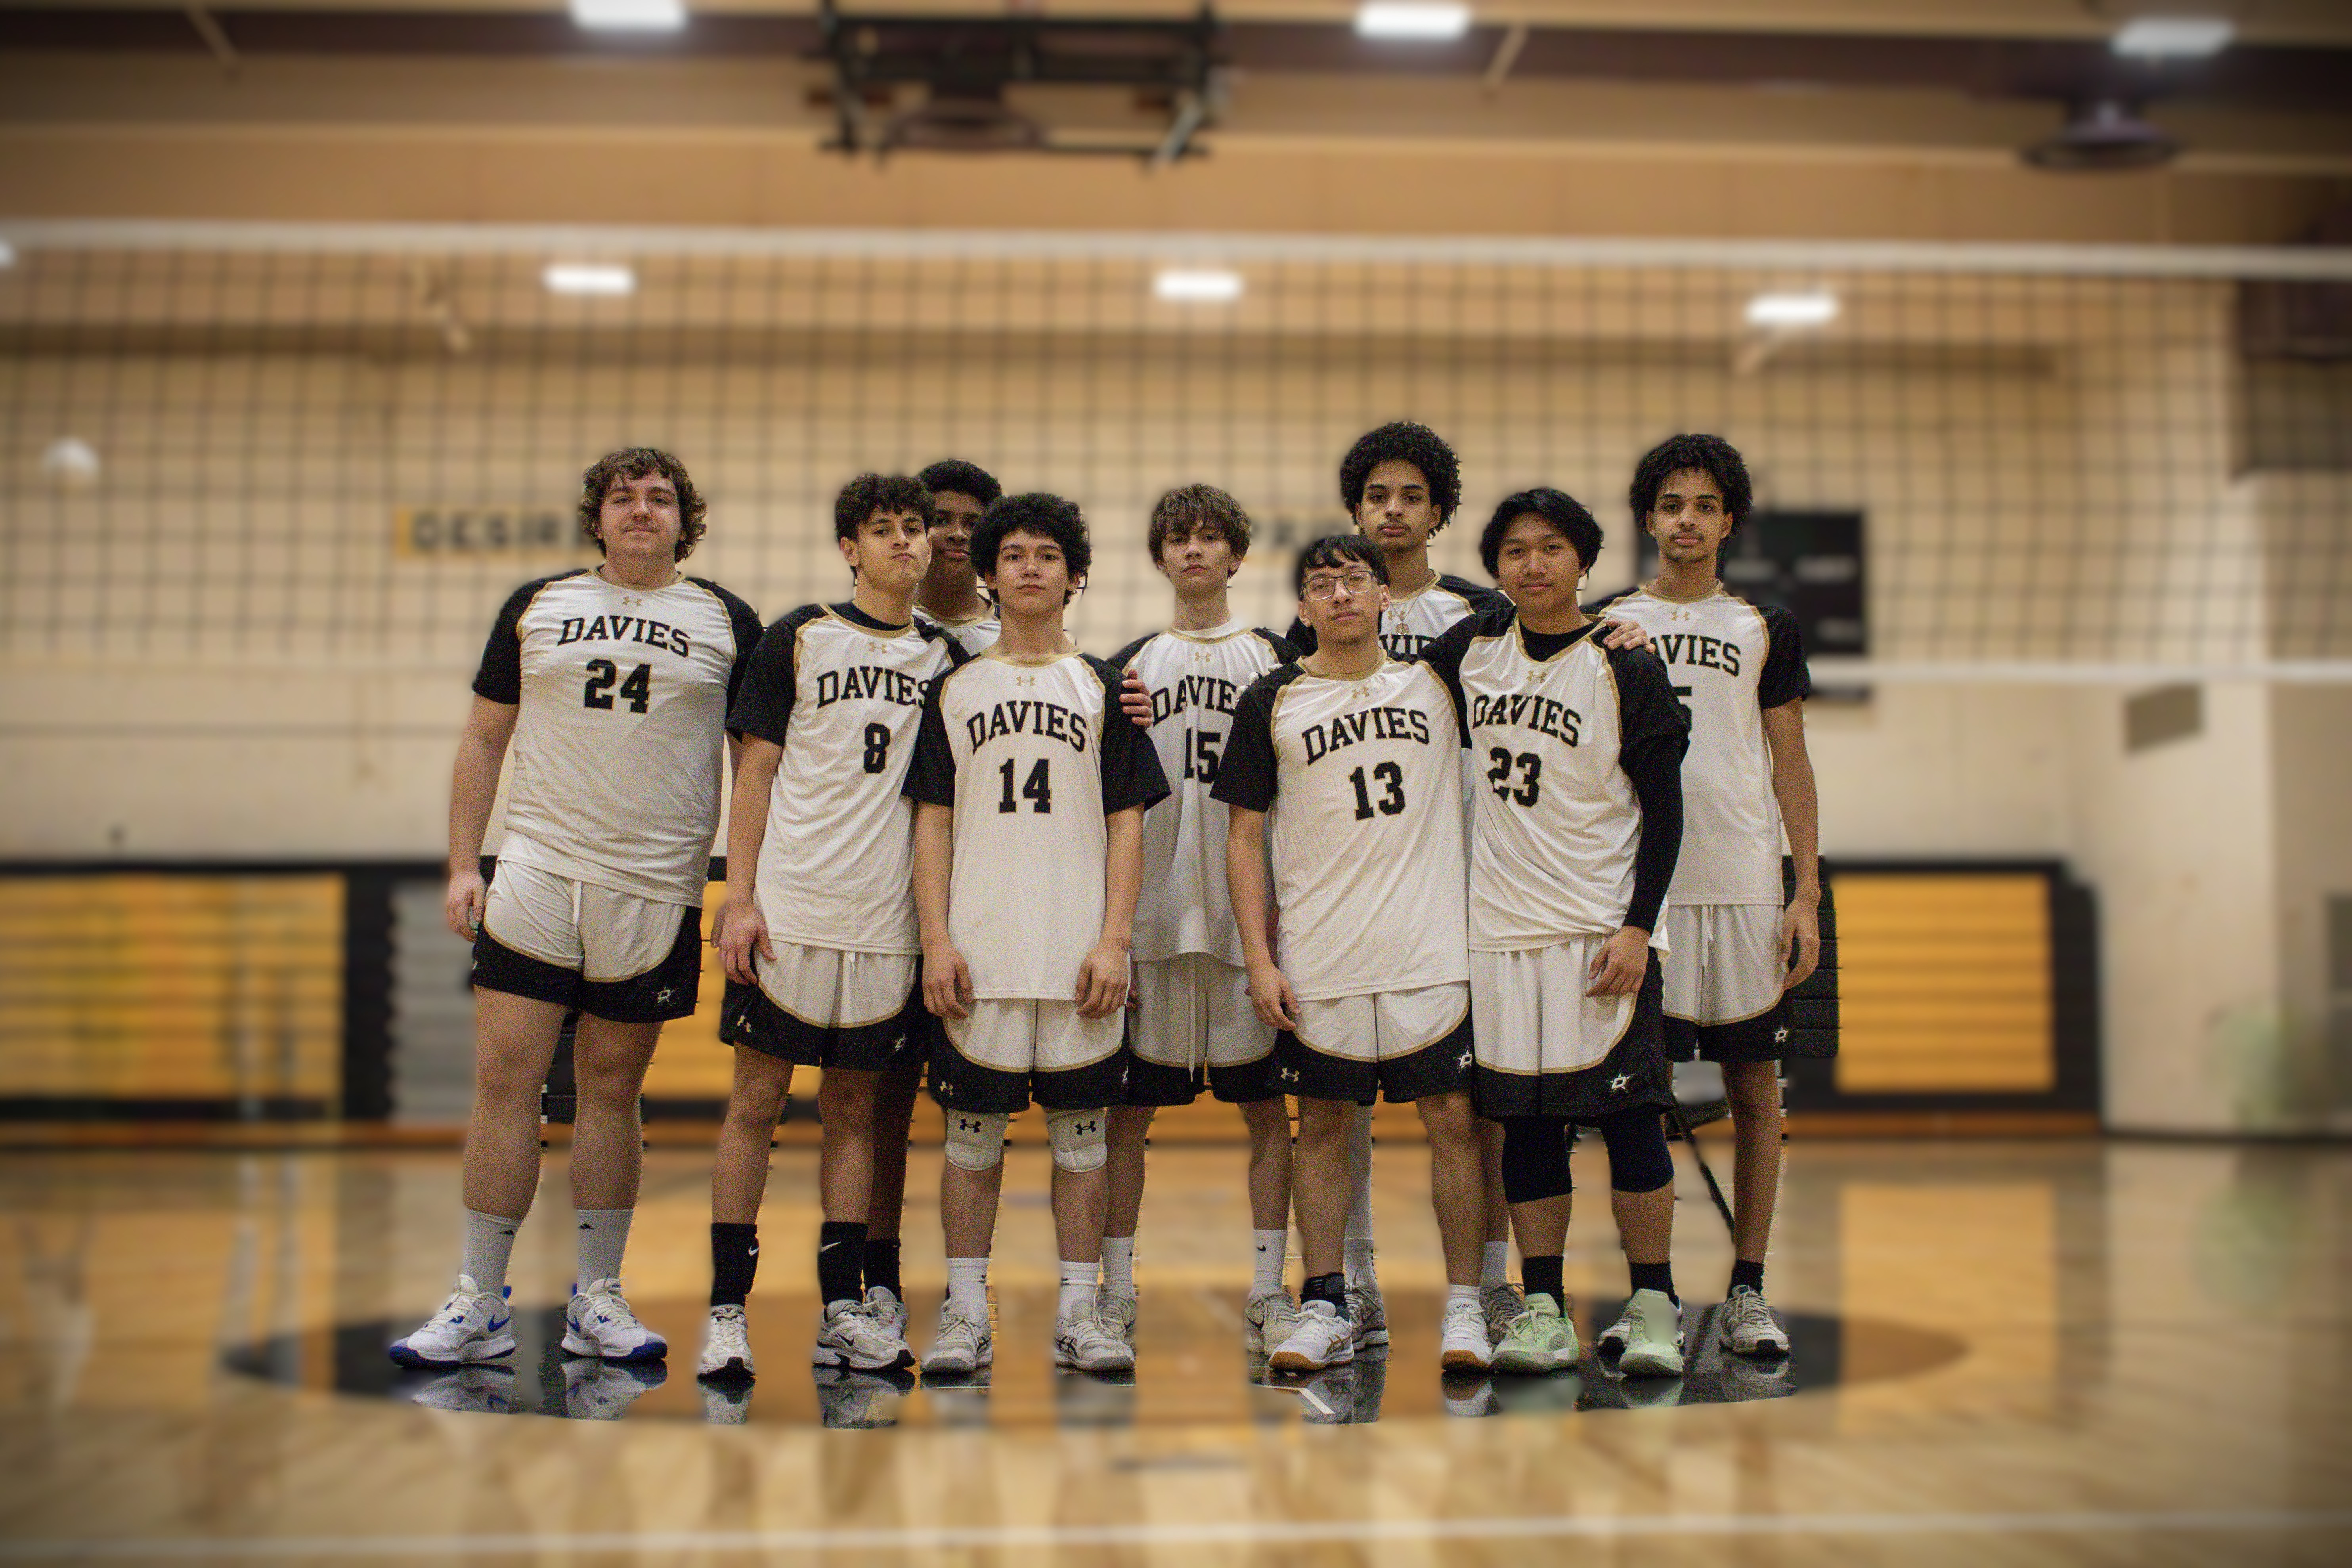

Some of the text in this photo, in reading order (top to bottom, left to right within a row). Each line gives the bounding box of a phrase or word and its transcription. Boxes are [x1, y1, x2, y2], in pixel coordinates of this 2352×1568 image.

[557, 615, 690, 658] DAVIES
[1650, 634, 1741, 677] VIES
[584, 659, 651, 713] 24
[1150, 675, 1237, 727] DAVIE
[966, 700, 1088, 754] DAVIES
[1302, 706, 1429, 765] DAVIES
[1472, 694, 1581, 748] DAVIES
[864, 723, 891, 774] 8
[1184, 727, 1221, 784] 15
[998, 758, 1051, 814] 14
[1349, 761, 1406, 821] 13
[1487, 747, 1542, 807] 23
